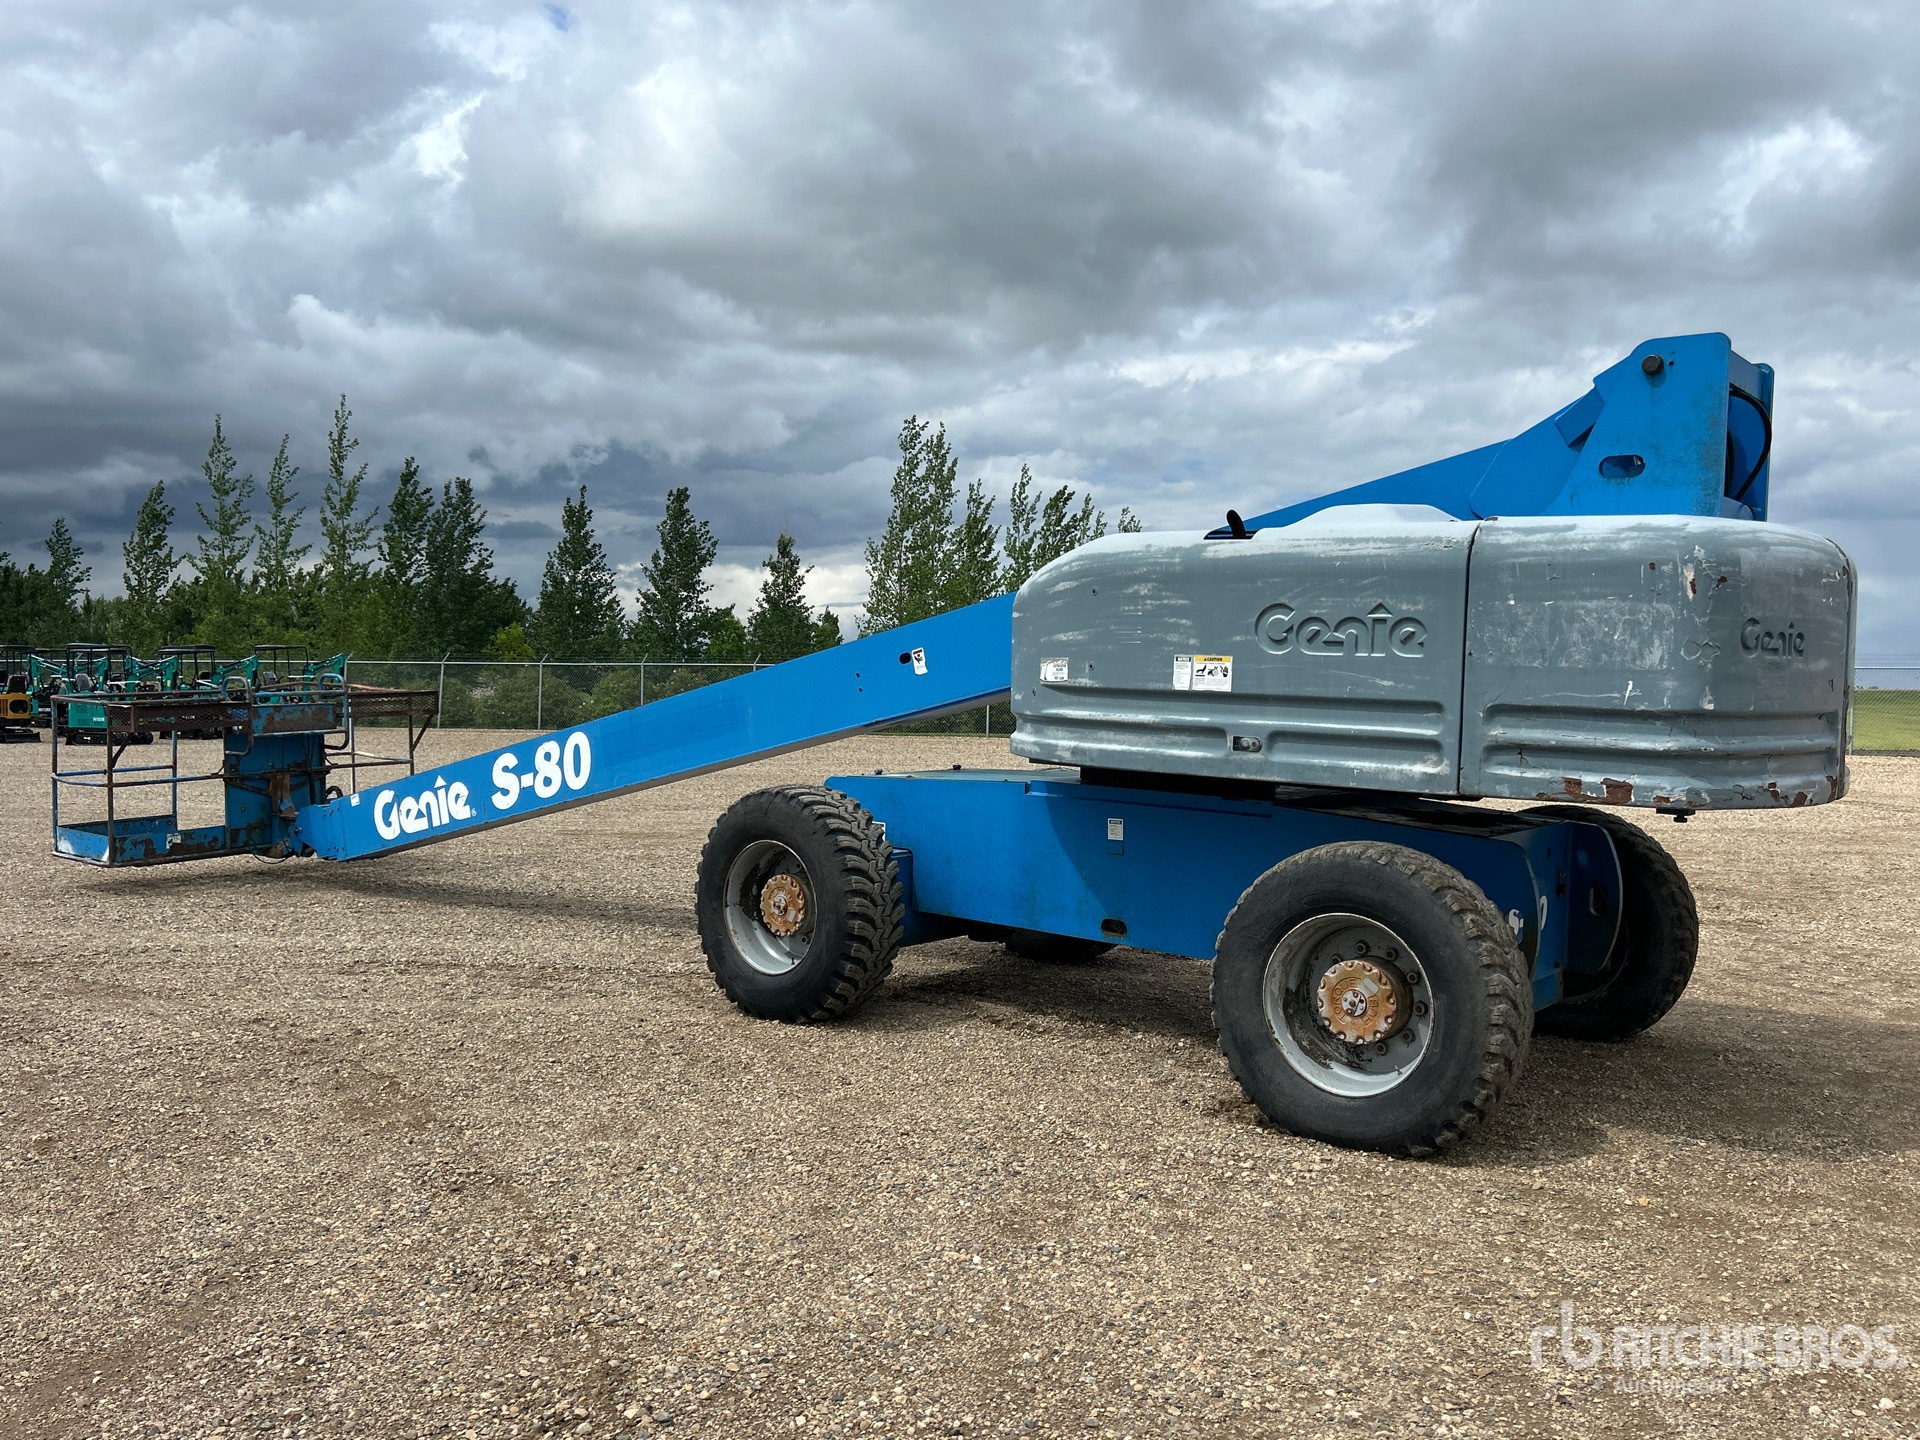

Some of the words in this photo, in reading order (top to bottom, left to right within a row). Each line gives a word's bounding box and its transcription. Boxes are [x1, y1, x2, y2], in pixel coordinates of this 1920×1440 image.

[1254, 602, 1428, 657] Genie
[1740, 617, 1806, 659] Genie
[374, 775, 471, 840] Genie
[491, 731, 591, 810] S-80
[1332, 979, 1356, 1022] TORQUE
